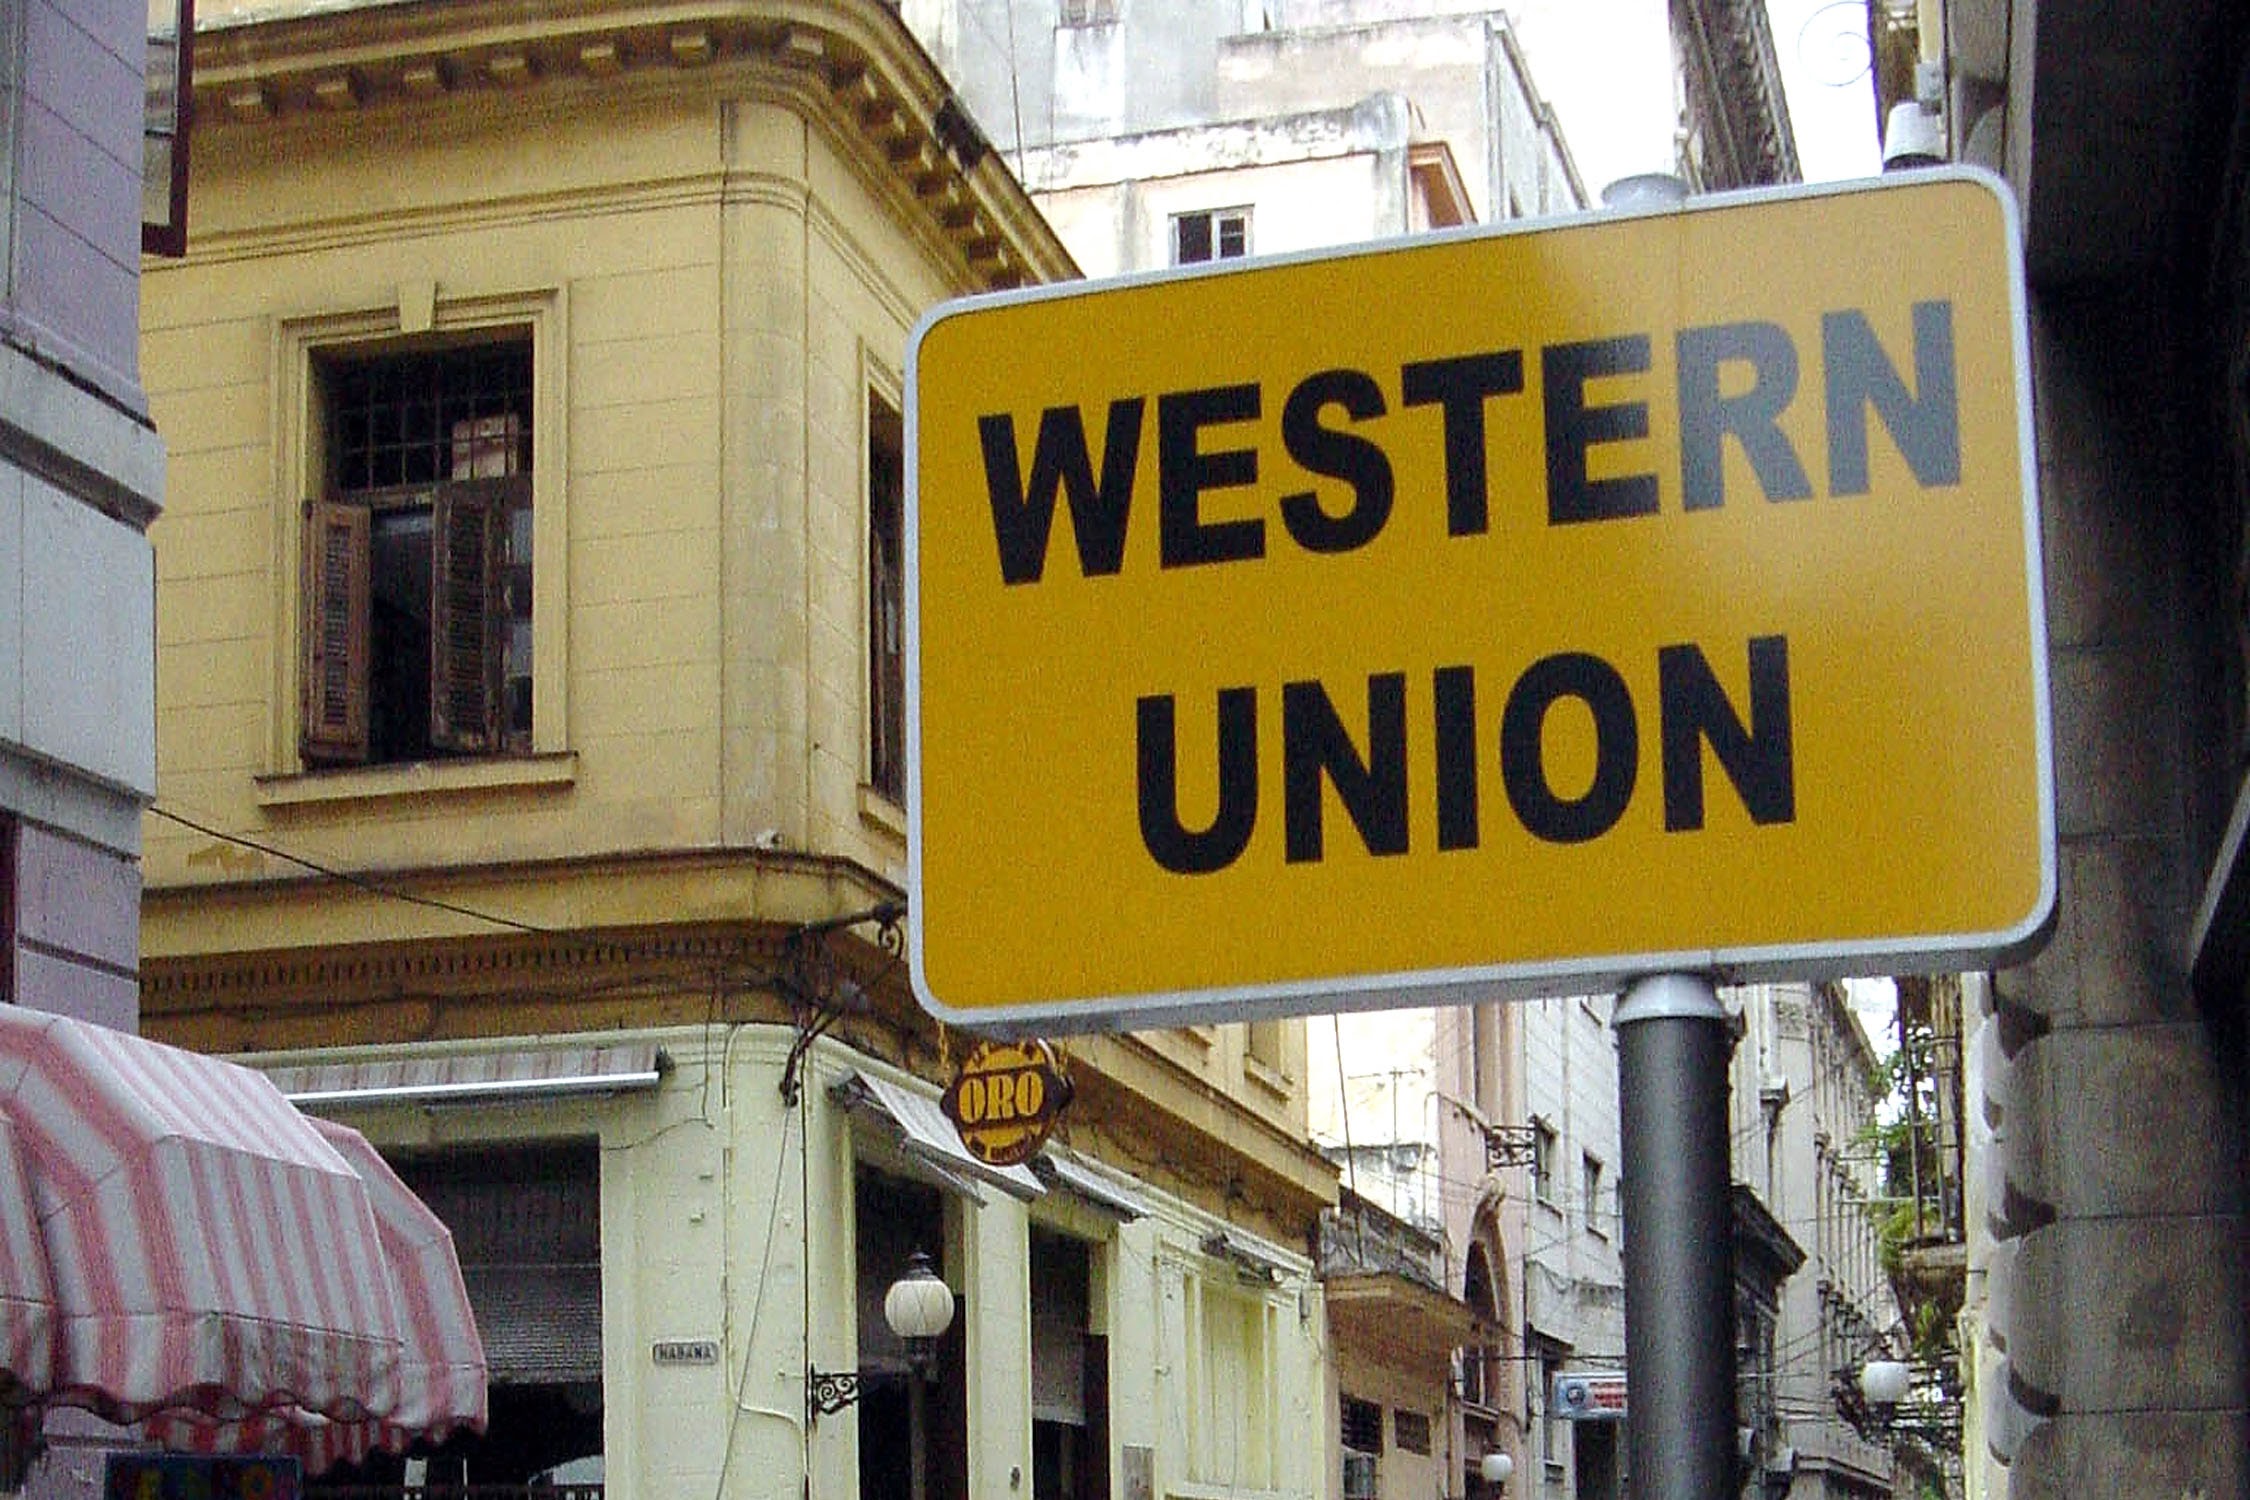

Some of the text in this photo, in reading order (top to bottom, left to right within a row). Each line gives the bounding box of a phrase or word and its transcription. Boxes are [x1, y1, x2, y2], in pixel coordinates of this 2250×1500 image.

[977, 299, 1961, 586] WESTERN
[1136, 634, 1797, 876] UNION
[958, 1070, 1044, 1124] ORO
[659, 1345, 712, 1360] HABANA
